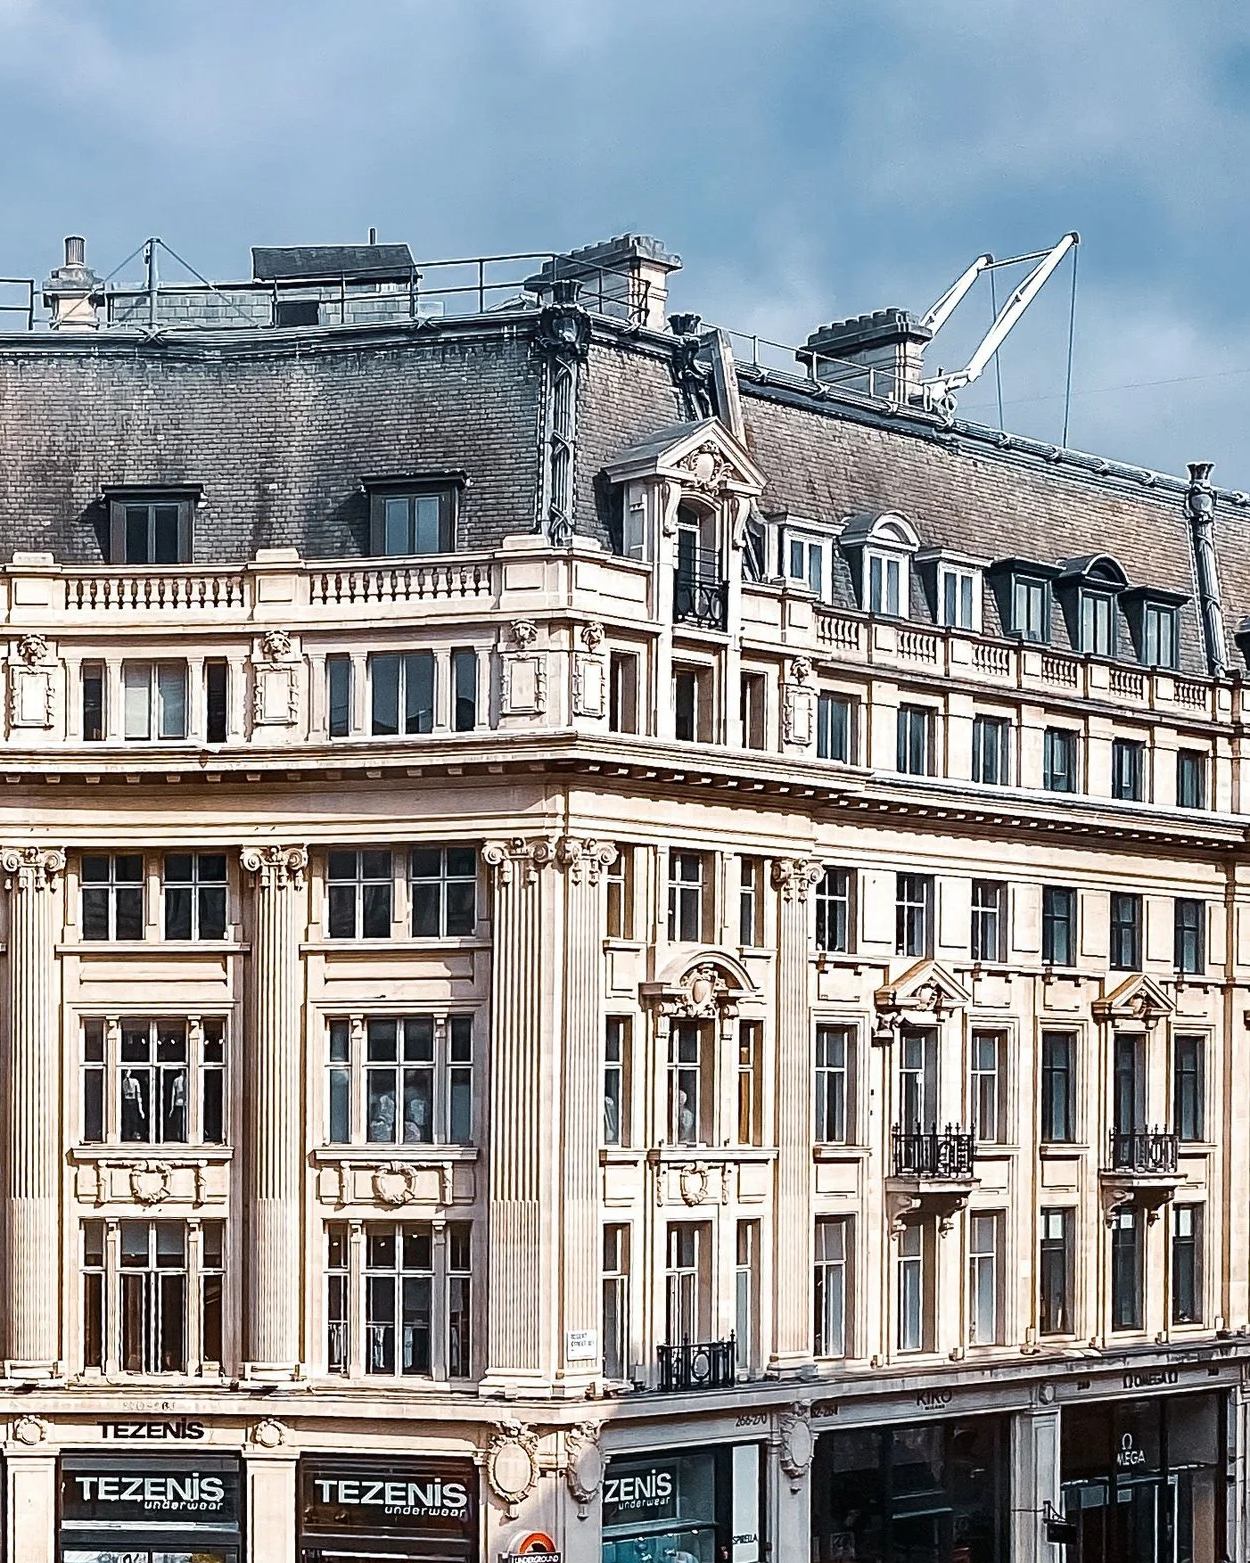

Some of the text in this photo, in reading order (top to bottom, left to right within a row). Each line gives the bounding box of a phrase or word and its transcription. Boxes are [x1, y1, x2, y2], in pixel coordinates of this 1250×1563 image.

[916, 1391, 953, 1406] KIKO
[97, 1417, 205, 1439] TEZENIS
[75, 1472, 225, 1502] TEZENIS
[314, 1477, 468, 1508] TEZENIS
[603, 1468, 673, 1504] ZENIS
[143, 1499, 224, 1511] underwear
[383, 1505, 467, 1518] underwear
[617, 1496, 671, 1511] underwear
